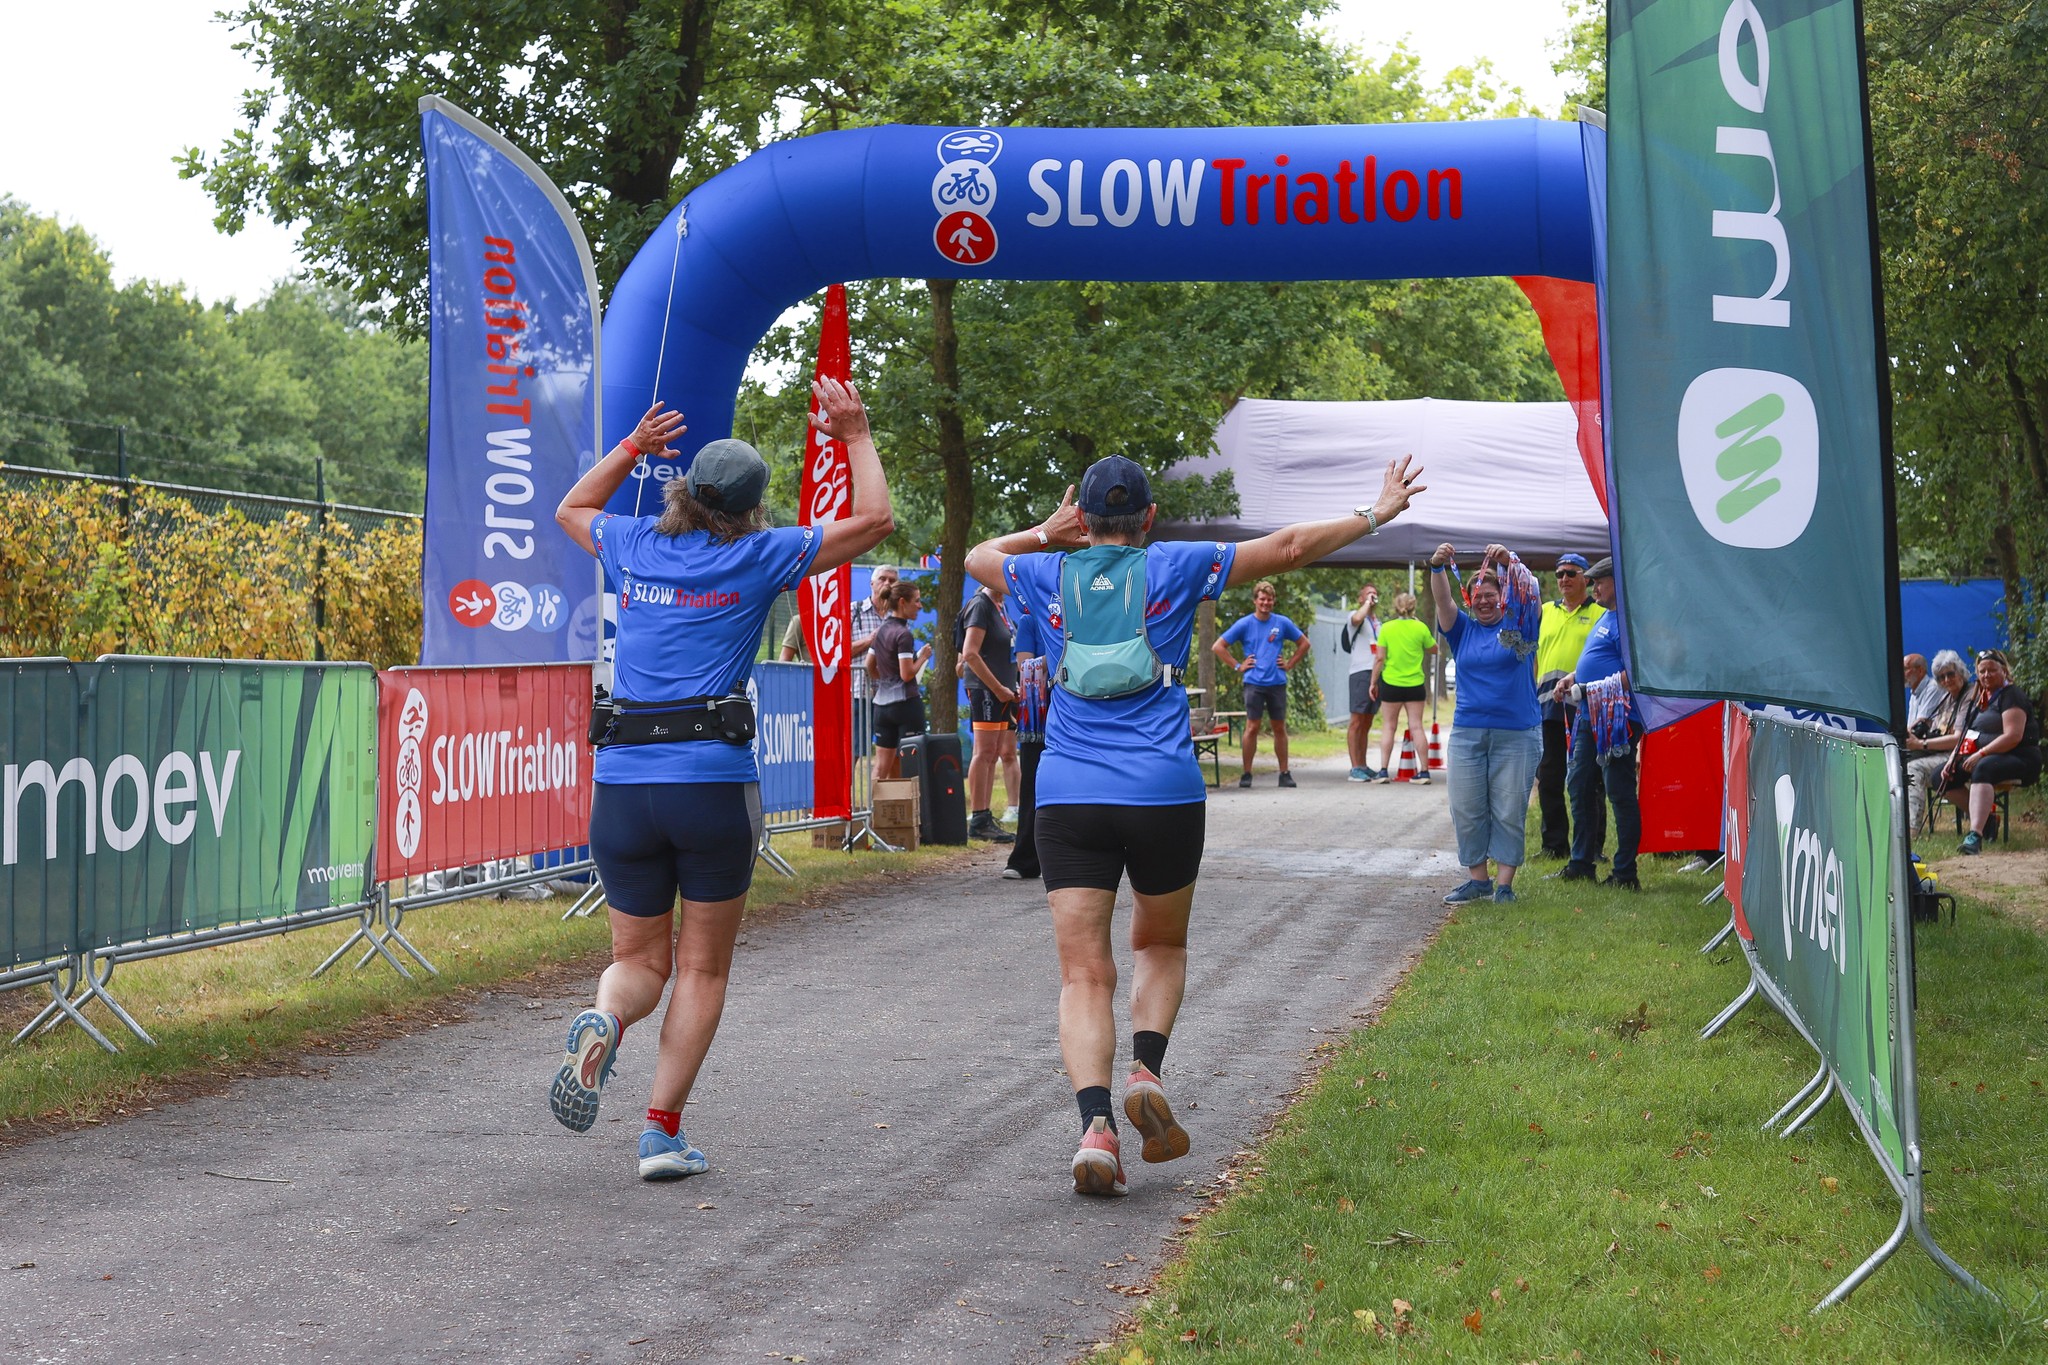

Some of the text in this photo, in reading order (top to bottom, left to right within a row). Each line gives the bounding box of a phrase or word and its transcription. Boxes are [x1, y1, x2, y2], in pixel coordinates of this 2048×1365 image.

[1027, 154, 1463, 228] SLOWTriatlon
[1712, 0, 1791, 328] mo
[630, 463, 691, 481] oev
[633, 583, 740, 608] SLOWTriatlon
[431, 725, 577, 805] SLOWTriatlon
[763, 711, 814, 766] SLOWTria
[3, 750, 241, 865] moev
